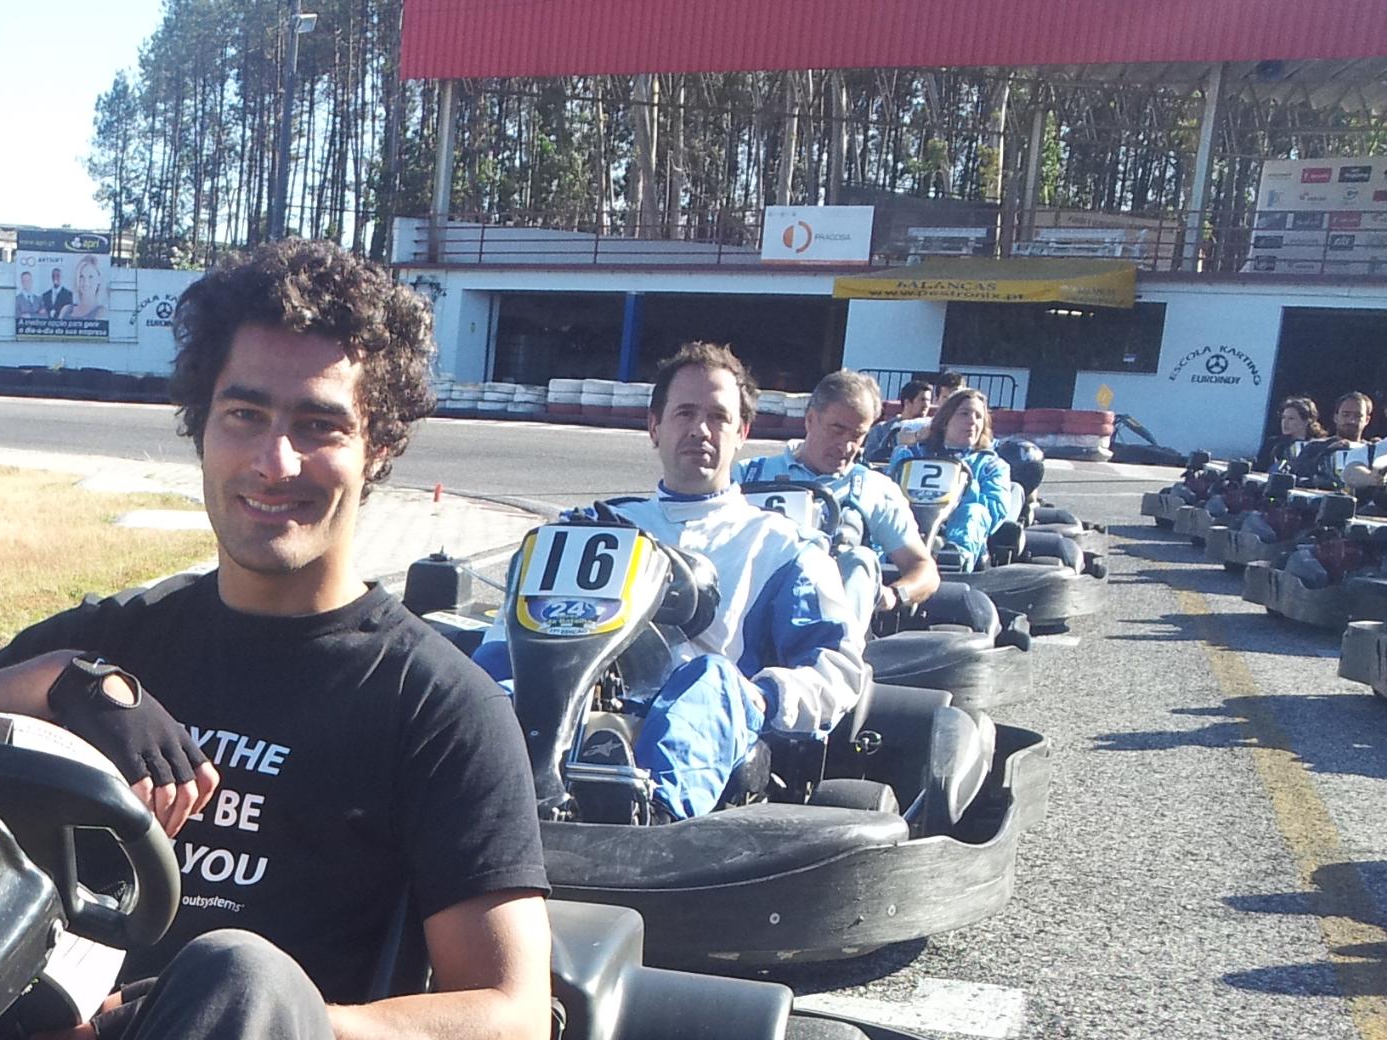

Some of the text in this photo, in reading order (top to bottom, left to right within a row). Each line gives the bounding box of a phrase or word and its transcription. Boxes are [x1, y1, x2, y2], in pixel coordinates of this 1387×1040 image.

[83, 238, 100, 250] apri
[1169, 345, 1262, 386] ESCOLA KARTING
[1191, 374, 1241, 384] EUROINDY
[919, 464, 943, 489] 2
[539, 531, 619, 591] 16
[549, 601, 586, 617] 24
[214, 789, 265, 832] BE
[181, 843, 268, 886] YOU
[182, 894, 240, 913] outsystems
